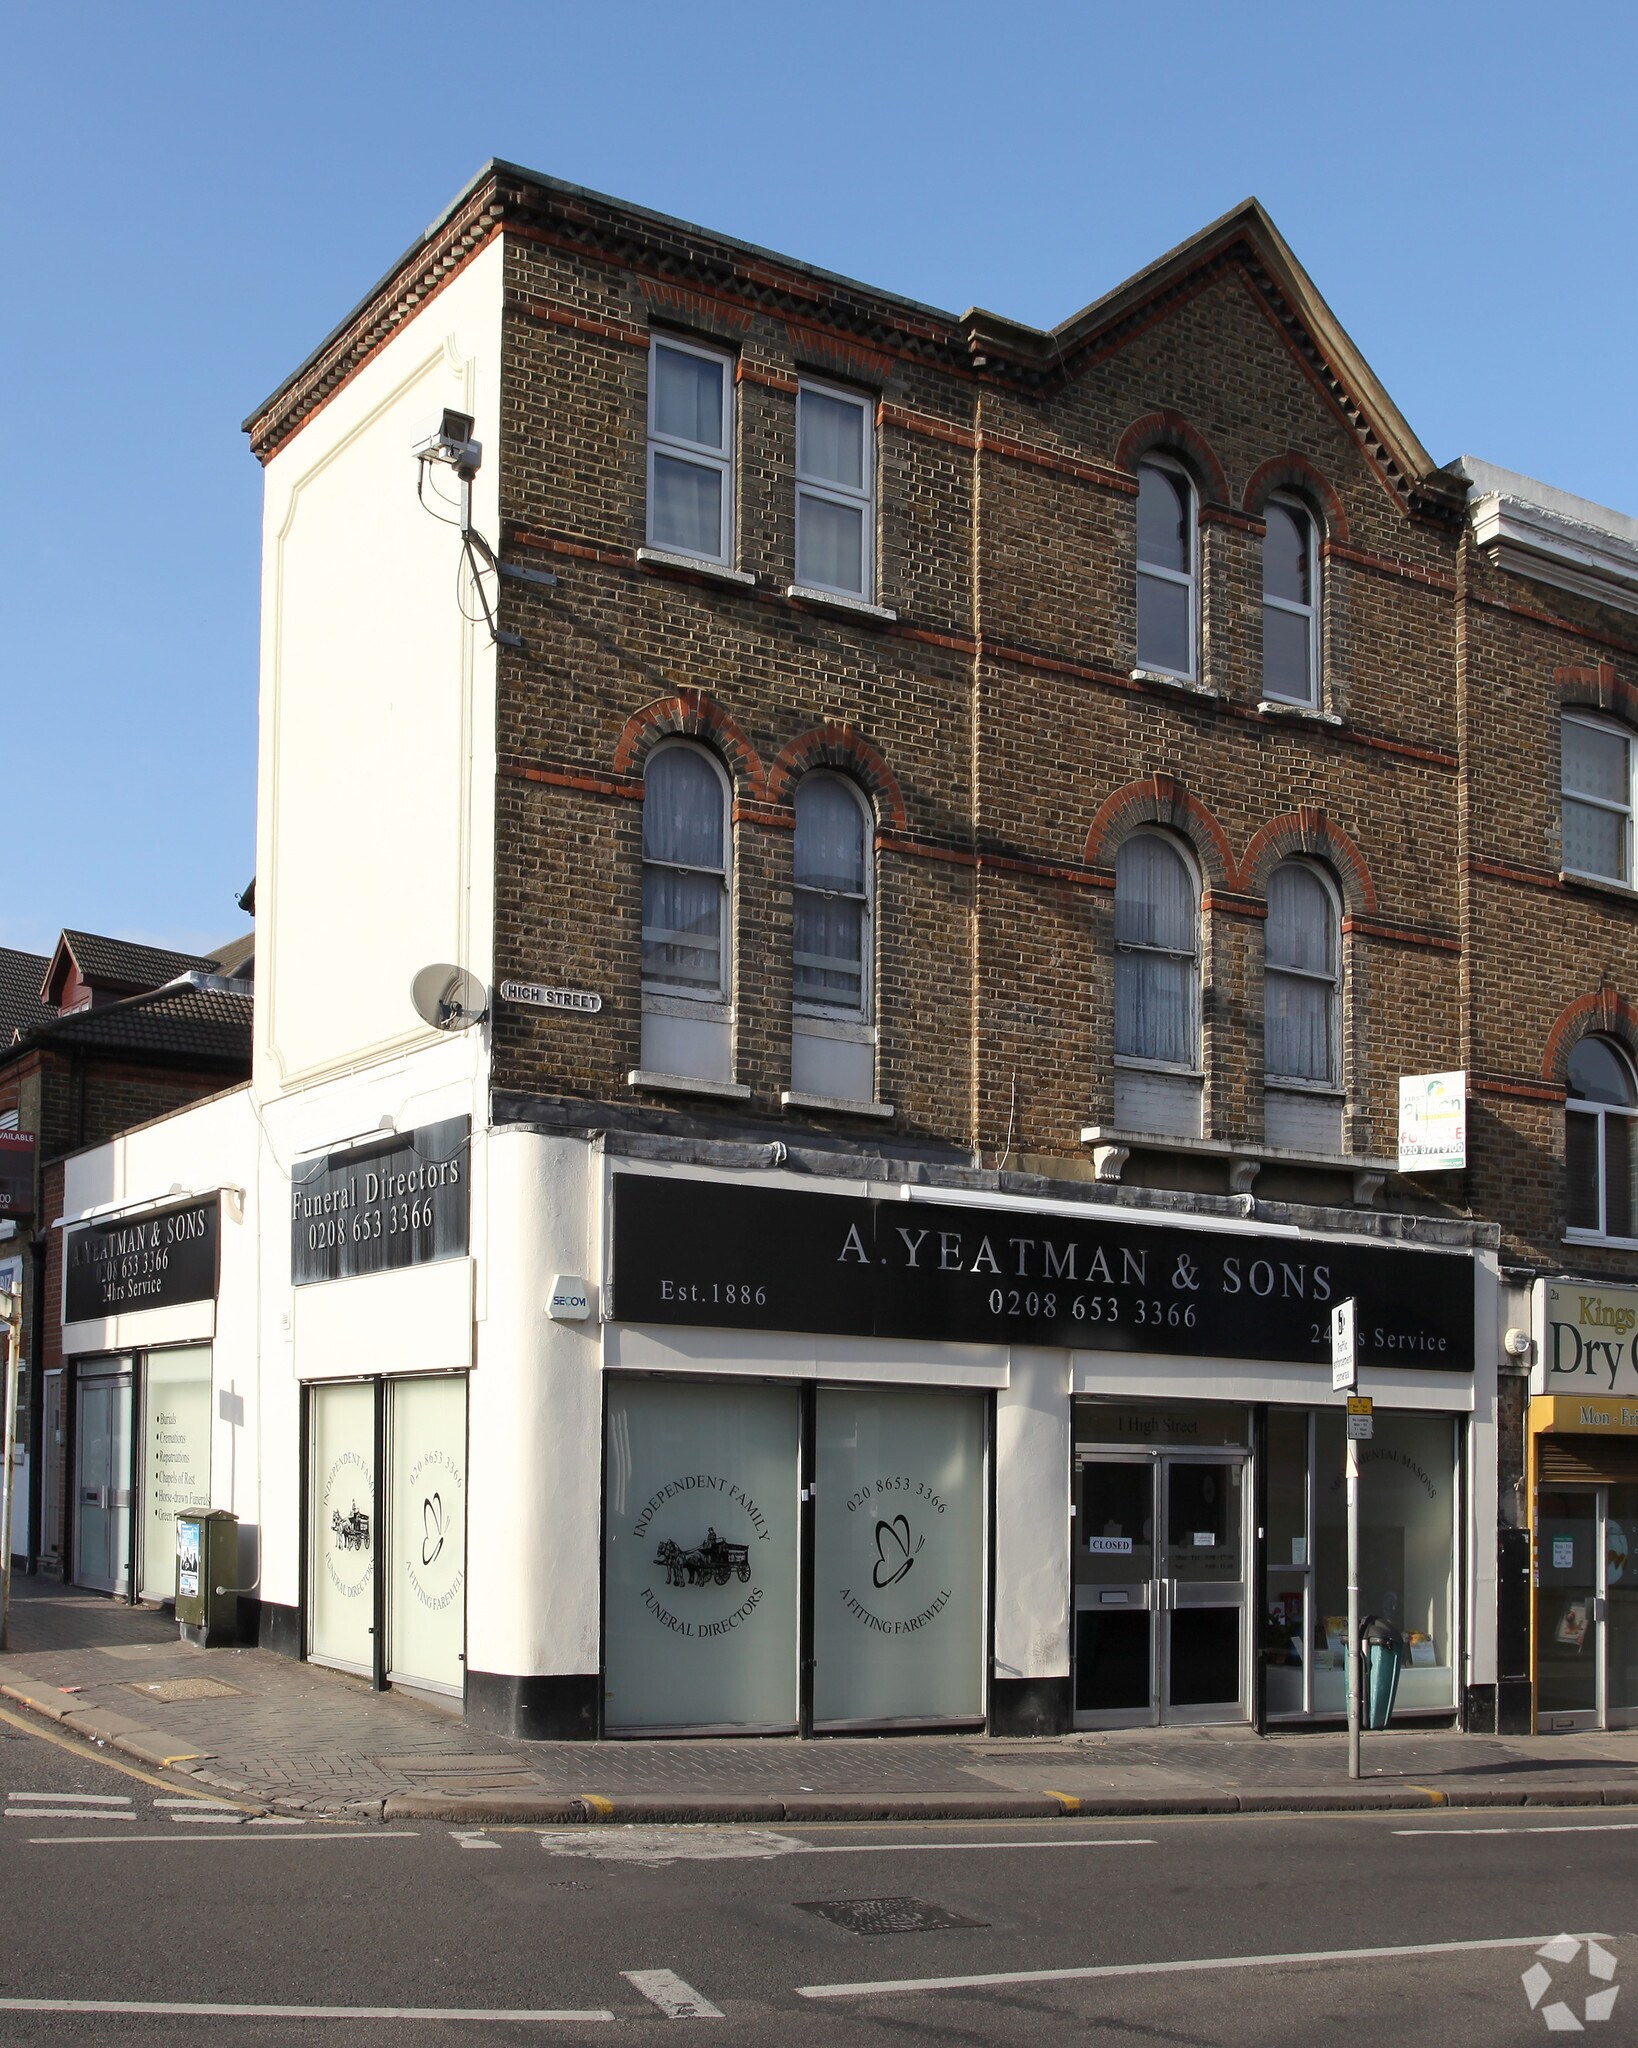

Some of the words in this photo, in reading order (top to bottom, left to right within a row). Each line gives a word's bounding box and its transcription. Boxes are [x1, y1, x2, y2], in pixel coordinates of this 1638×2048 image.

[507, 984, 540, 1001] HIGH
[545, 990, 597, 1008] STREET
[1401, 1146, 1419, 1155] 020
[292, 1176, 356, 1220] Funeral
[365, 1159, 459, 1204] Directors
[151, 1221, 161, 1247] &
[167, 1209, 205, 1244] SONS
[309, 1217, 346, 1250] 0208
[353, 1210, 381, 1242] 653
[390, 1197, 433, 1234] 3366
[96, 1260, 118, 1283] 0208
[122, 1255, 139, 1278] 653
[143, 1247, 169, 1274] 3366
[836, 1222, 1147, 1287] A.YEATMAN
[1172, 1253, 1200, 1290] &
[1221, 1257, 1332, 1301] SONS
[102, 1282, 125, 1302] 24hrs
[128, 1275, 162, 1298] Service
[554, 1296, 586, 1307] SECOM
[661, 1280, 767, 1306] Est.1886
[1550, 1289, 1560, 1301] 2a
[988, 1288, 1056, 1319] 0208
[1071, 1295, 1118, 1322] 653
[1134, 1302, 1196, 1328] 3366
[1311, 1323, 1366, 1346] 24s
[1374, 1327, 1448, 1353] Service
[1337, 1340, 1348, 1353] Traffic
[1549, 1321, 1624, 1391] Dry
[1336, 1370, 1350, 1382] cameras
[160, 1412, 177, 1425] Burials
[1119, 1416, 1123, 1431] 1
[1129, 1416, 1159, 1435] High
[1163, 1418, 1198, 1433] Street
[1580, 1406, 1610, 1426] Mon
[160, 1431, 186, 1444] Cremations
[159, 1449, 190, 1466] Repatriations
[409, 1460, 423, 1486] 020
[424, 1450, 443, 1465] 8653
[445, 1456, 463, 1489] 3366
[159, 1470, 177, 1487] Chapels
[178, 1472, 184, 1485] of
[185, 1471, 196, 1485] Rest
[323, 1451, 363, 1507] INDEPENDENT
[1401, 1455, 1437, 1499] MASONS
[158, 1489, 189, 1504] Horse-drawn
[189, 1491, 210, 1507] Funerals
[633, 1475, 728, 1539] INDEPENDENT
[729, 1485, 770, 1542] FAMILY
[847, 1486, 871, 1513] 020
[876, 1476, 911, 1494] 8653
[916, 1482, 948, 1515] 3366
[158, 1508, 173, 1521] Green
[1093, 1541, 1130, 1551] CLOSED
[325, 1552, 346, 1596] FUNERAL
[406, 1561, 412, 1571] A
[409, 1570, 432, 1609] FITTING
[640, 1588, 695, 1637] FUNERAL
[698, 1587, 764, 1638] DIRECTORS
[840, 1588, 851, 1600] A
[847, 1598, 892, 1634] FITTING
[894, 1588, 952, 1635] FAREWELL
